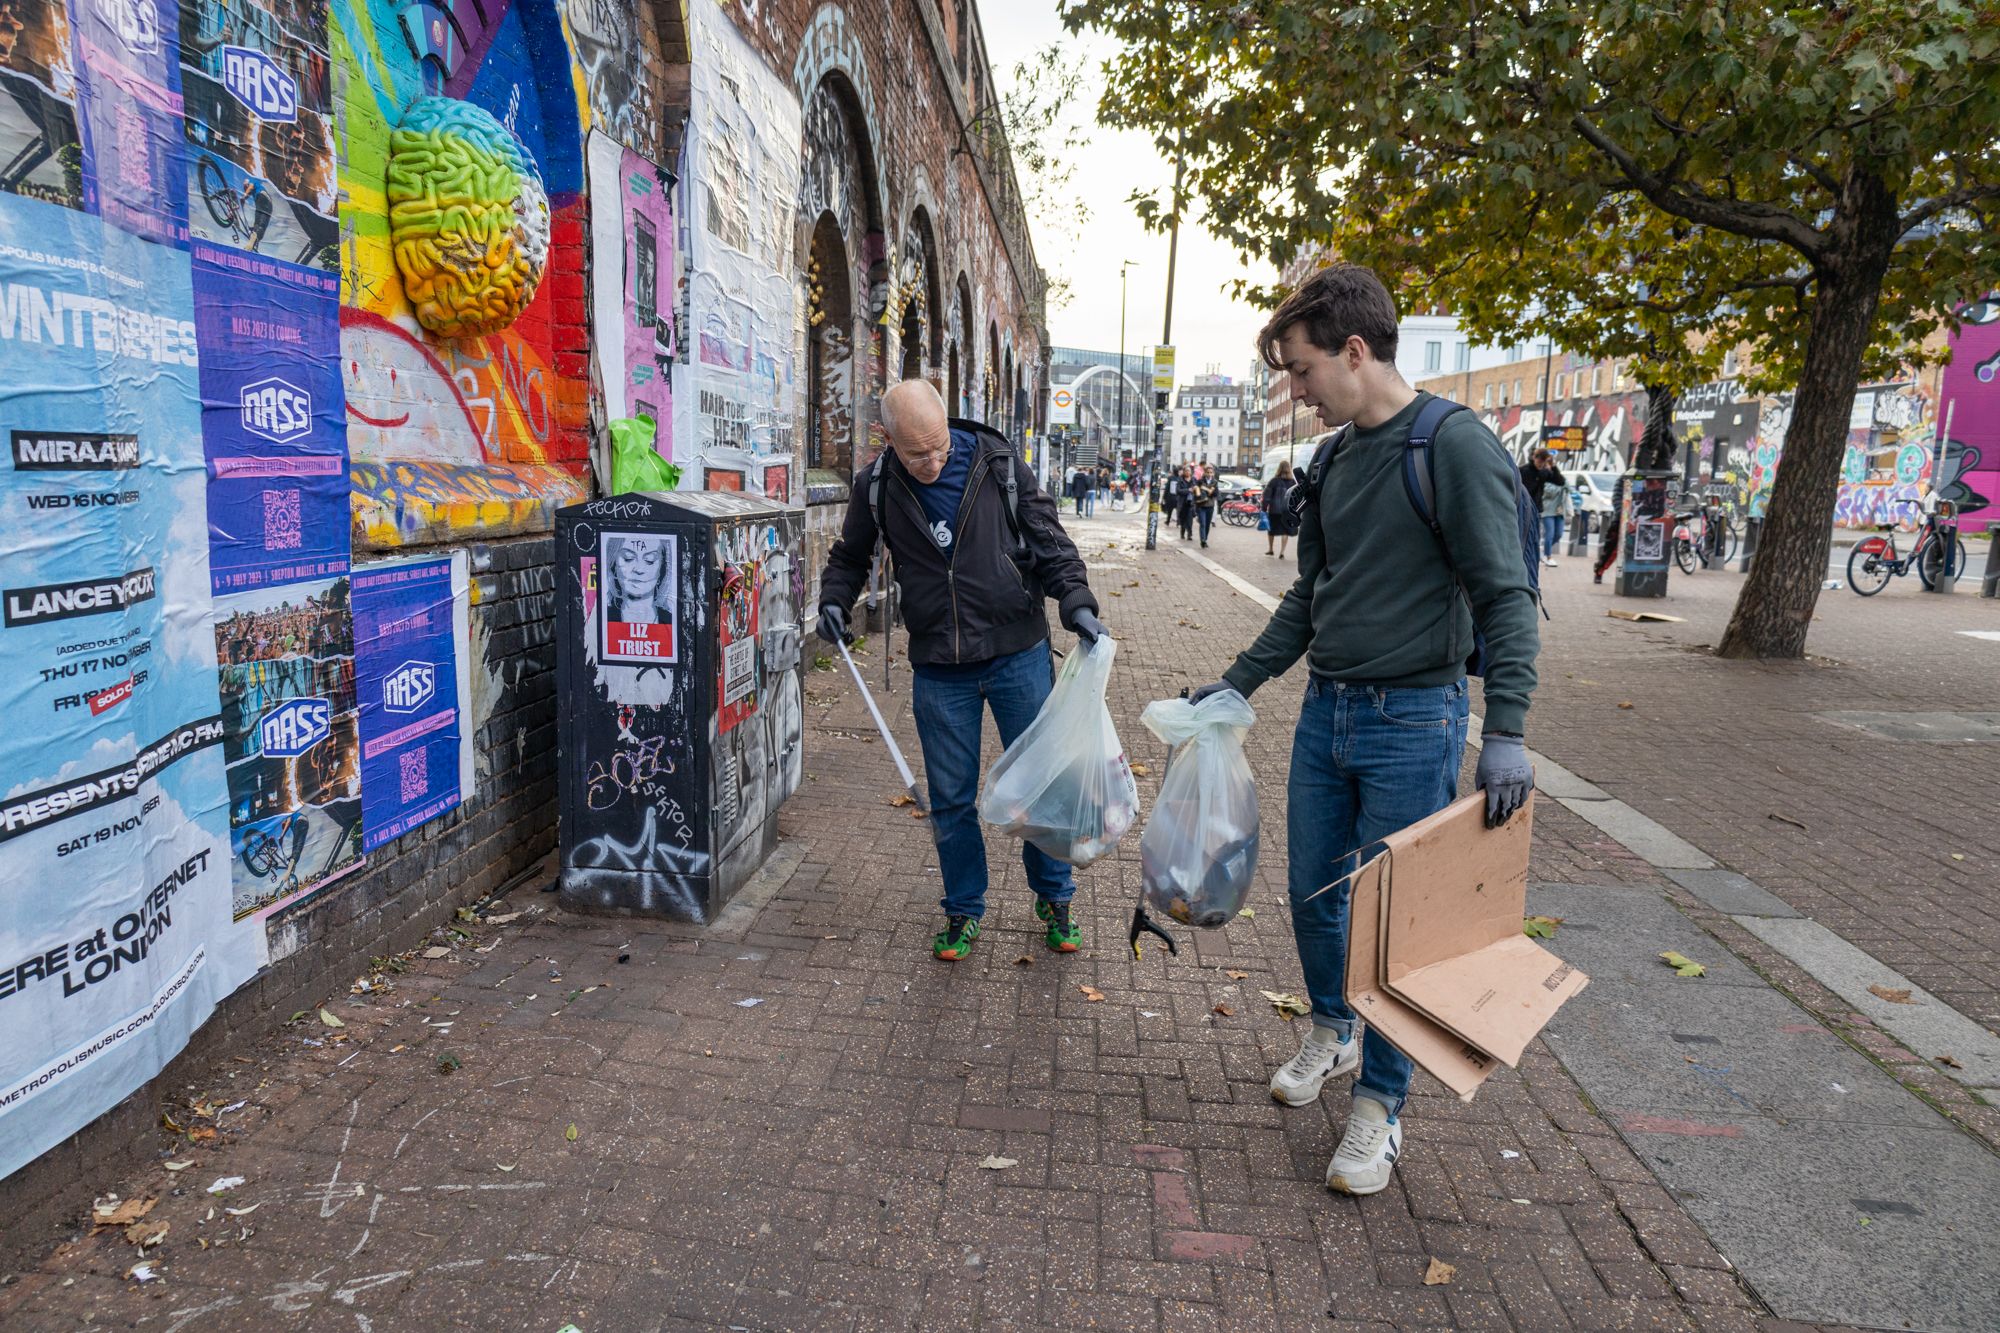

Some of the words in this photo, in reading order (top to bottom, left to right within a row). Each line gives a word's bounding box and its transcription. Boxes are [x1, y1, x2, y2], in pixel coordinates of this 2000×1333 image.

[227, 52, 296, 116] NASS
[45, 255, 89, 272] MUSIC
[216, 252, 227, 267] DAY
[227, 254, 251, 272] FESTIVAL
[251, 259, 259, 273] OF
[277, 266, 294, 281] STREET
[232, 317, 250, 336] NASS
[251, 320, 268, 338] 2023
[268, 323, 275, 340] IS
[245, 387, 308, 434] NASS
[700, 390, 725, 418] HAIR
[725, 400, 736, 420] TO
[736, 402, 746, 419] BE
[19, 439, 117, 463] MIRAA
[27, 495, 71, 510] WED
[72, 494, 90, 508] 16
[214, 576, 221, 589] 6
[226, 574, 231, 588] 9
[232, 571, 247, 586] JULY
[248, 570, 262, 585] 2023
[271, 567, 295, 582] SHEPTON
[327, 560, 348, 574] BRISTOL
[9, 583, 127, 620] LANCEY
[97, 637, 119, 648] DUE
[630, 623, 649, 639] LIZ
[618, 639, 661, 656] TRUST
[40, 662, 79, 683] THU
[81, 659, 100, 674] 17
[97, 687, 125, 708] SOLD
[386, 668, 432, 707] NASS
[54, 694, 81, 712] FRI
[264, 705, 329, 751] NASS
[57, 834, 92, 858] SAT
[95, 826, 112, 843] 19
[74, 927, 107, 963] at
